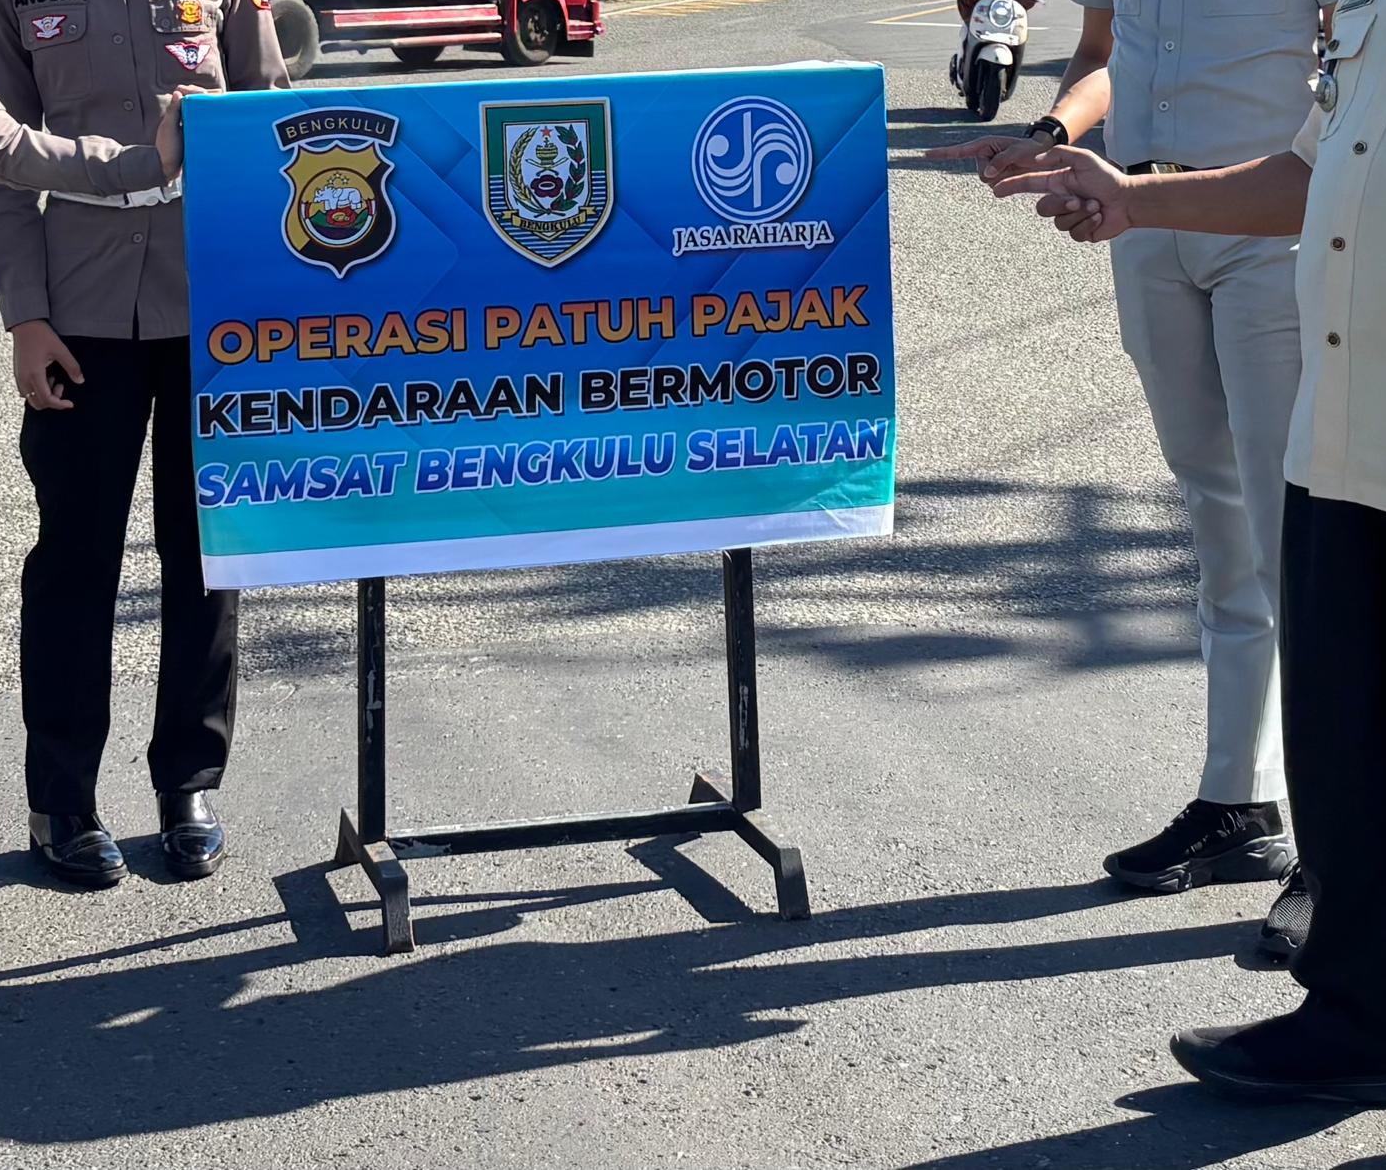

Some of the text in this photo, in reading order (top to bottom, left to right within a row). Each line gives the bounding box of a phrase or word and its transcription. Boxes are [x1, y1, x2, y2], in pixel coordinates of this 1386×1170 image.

[285, 117, 386, 139] BENGKULU
[519, 216, 581, 231] BENGKULU
[674, 223, 832, 255] JASA RAHARJA
[208, 284, 869, 366] OPERASI PATUH PAJAK
[196, 352, 881, 438] KENDARAAN BERMOTOR
[197, 418, 889, 509] SAMSAT BENGKULU SELATAN
